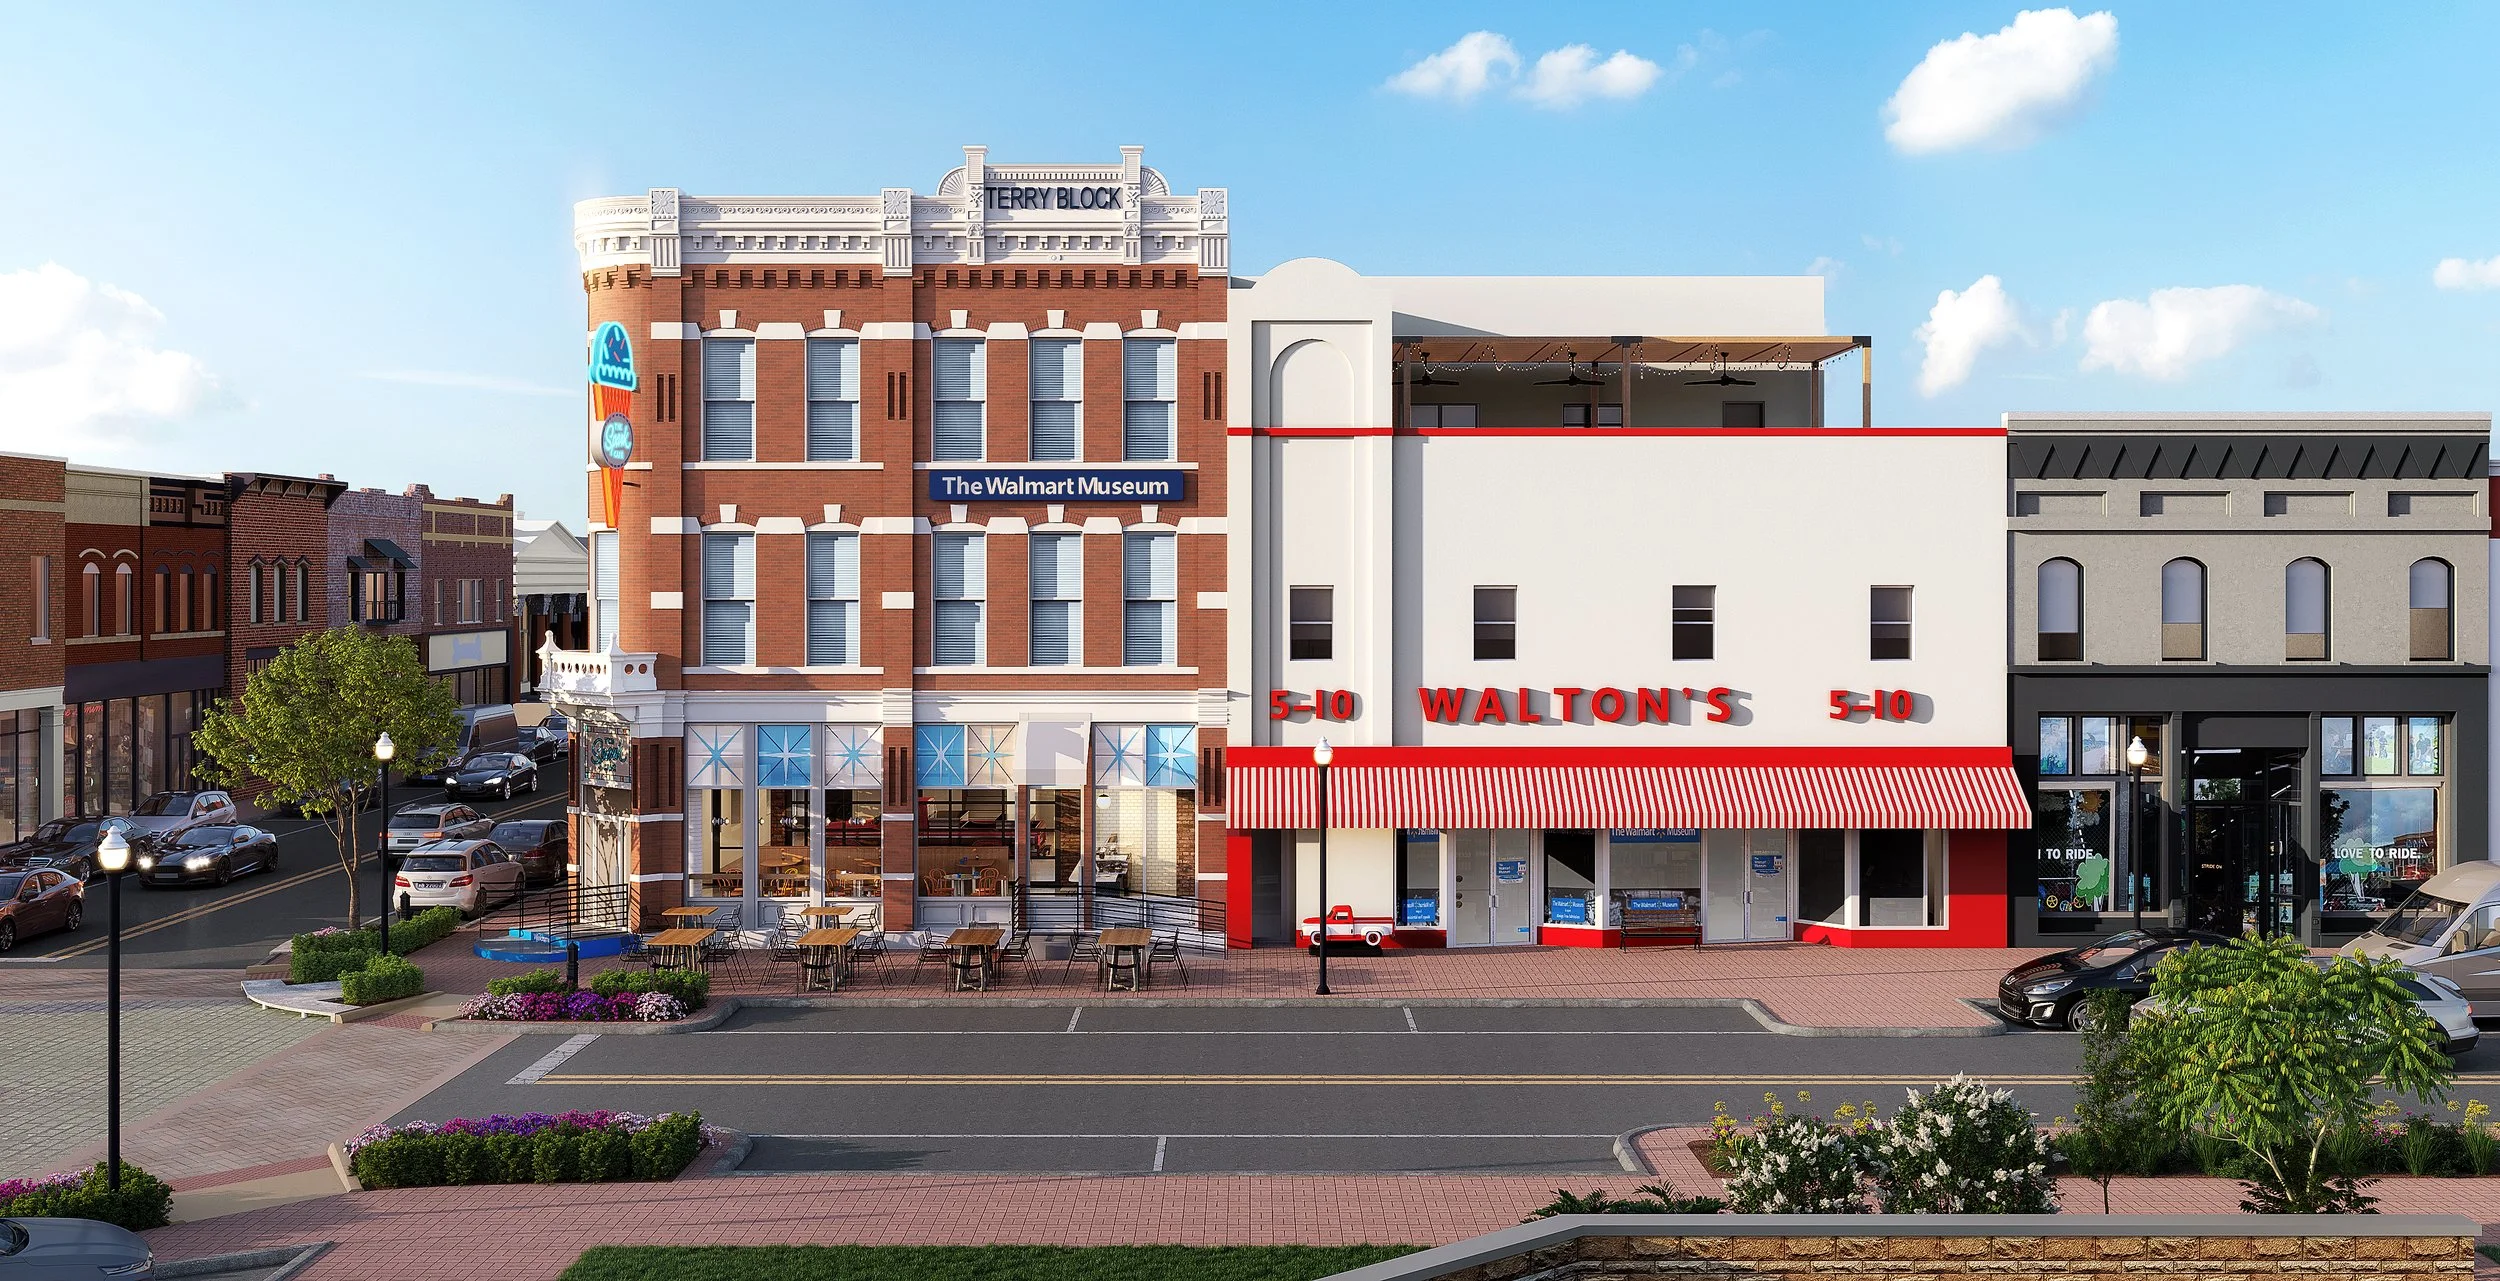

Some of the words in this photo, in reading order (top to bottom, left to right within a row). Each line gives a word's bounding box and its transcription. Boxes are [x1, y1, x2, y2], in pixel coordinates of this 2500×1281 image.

[985, 186, 1051, 210] TERRY
[1056, 186, 1122, 210] BLOCK
[942, 476, 984, 495] The
[985, 476, 1074, 495] Walmart
[1078, 476, 1169, 495] Museum
[1270, 689, 1353, 721] 5-10
[1417, 687, 1732, 723] WALTON'S
[1829, 689, 1913, 721] 5-10
[1612, 828, 1625, 837] The
[1625, 828, 1656, 837] Walmart
[1666, 828, 1696, 837] Museum
[2046, 848, 2061, 860] TO
[2334, 847, 2364, 859] LOVE
[2369, 847, 2384, 859] TO
[2389, 847, 2421, 859] RIDE.
